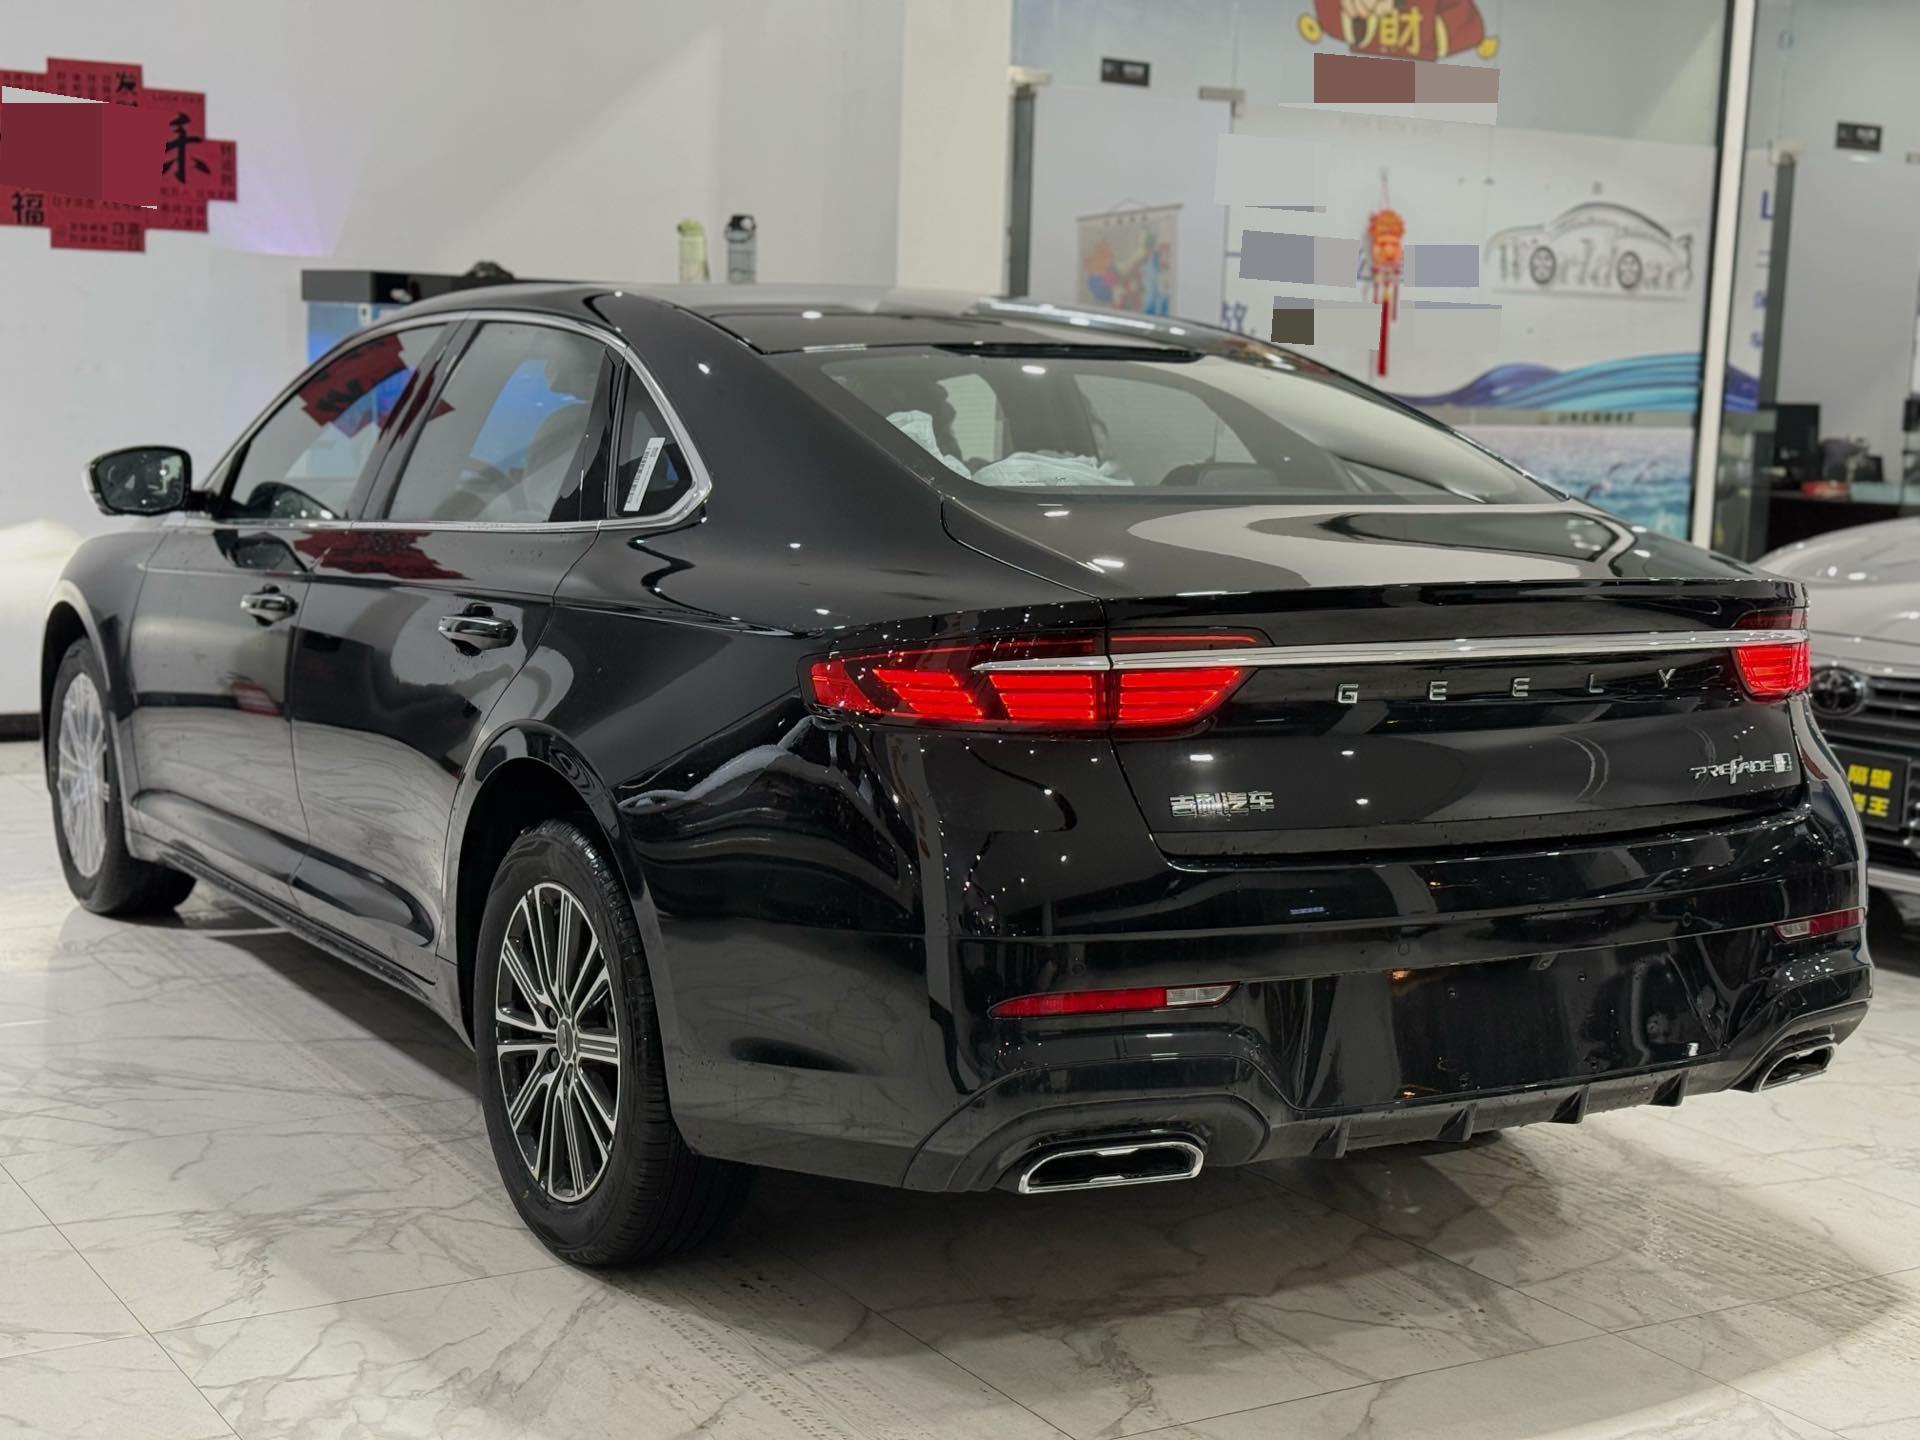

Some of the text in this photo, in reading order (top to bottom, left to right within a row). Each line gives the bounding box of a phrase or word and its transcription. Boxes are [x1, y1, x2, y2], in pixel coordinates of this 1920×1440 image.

[1337, 668, 1677, 704] GEELY
[1169, 789, 1275, 817] 吉利汽车
